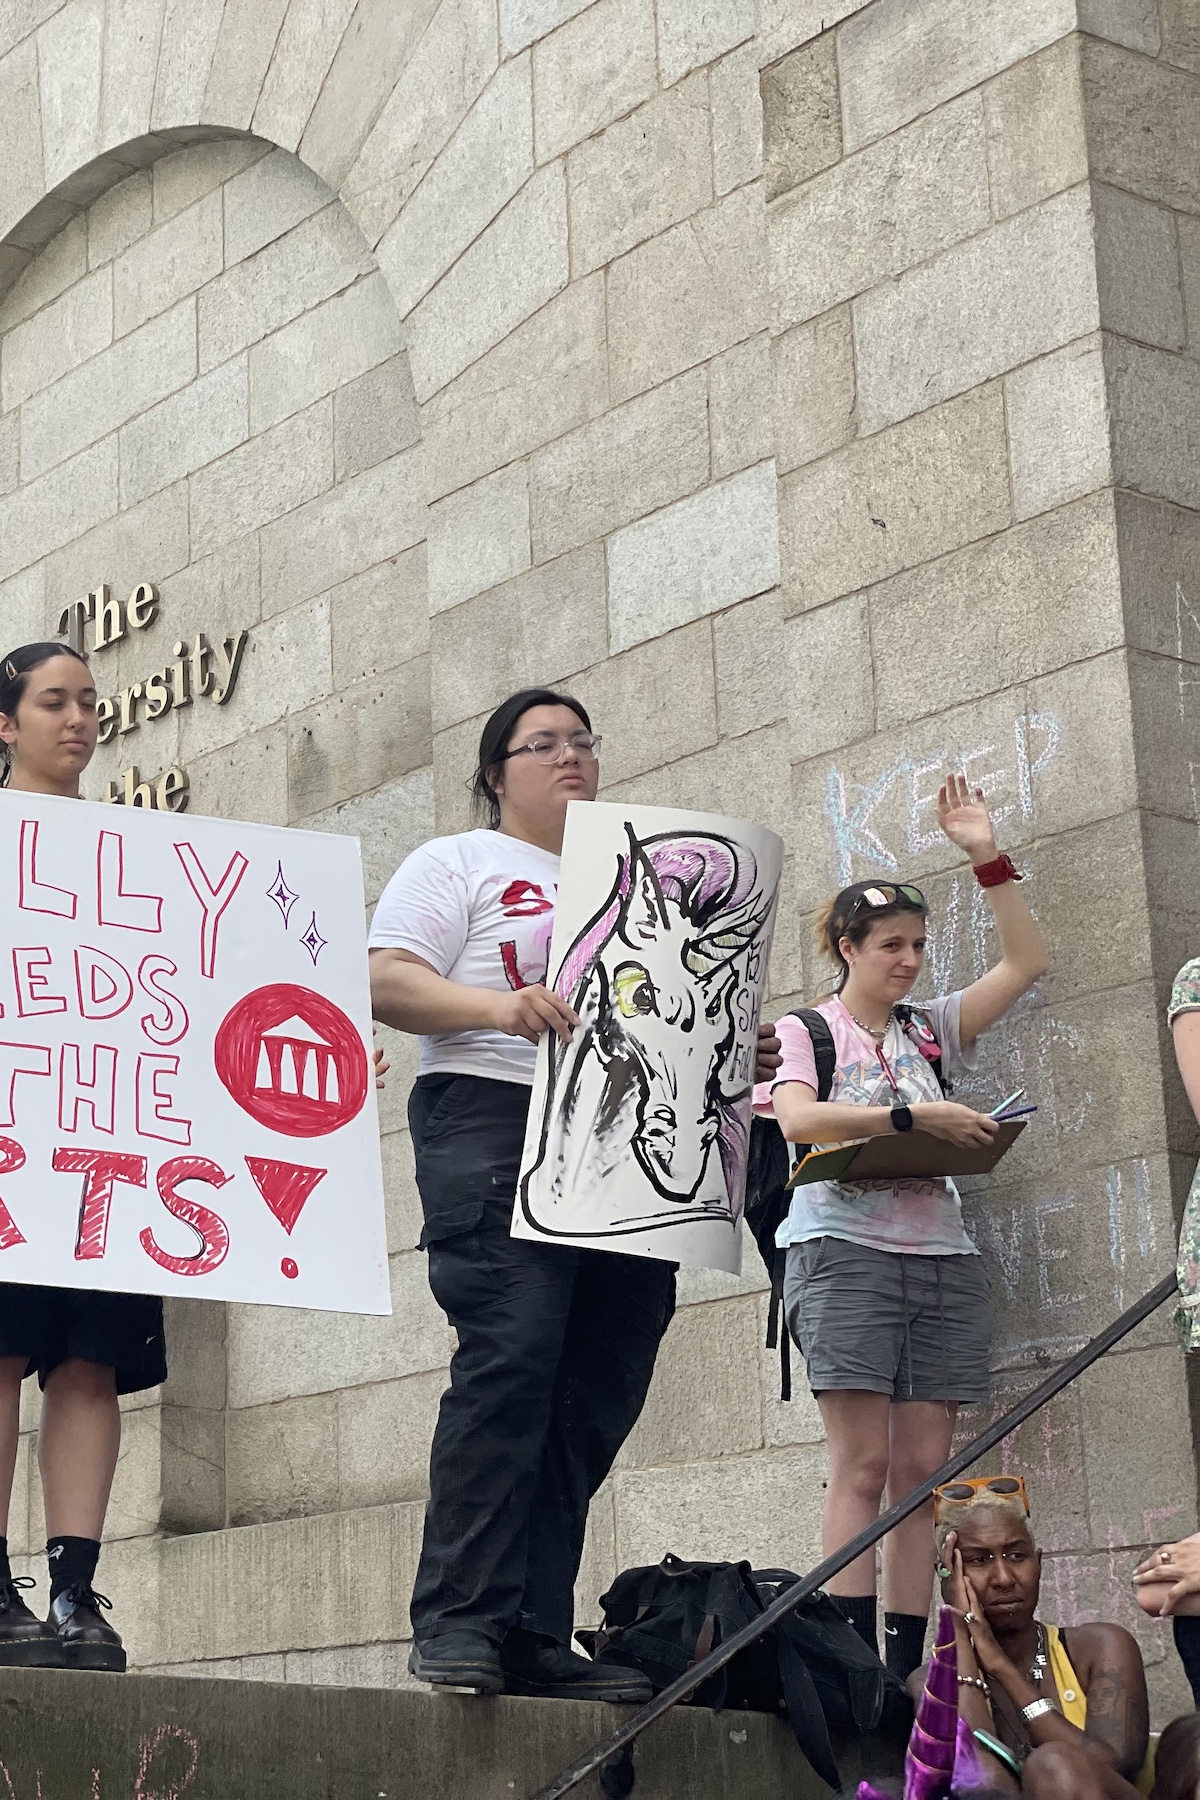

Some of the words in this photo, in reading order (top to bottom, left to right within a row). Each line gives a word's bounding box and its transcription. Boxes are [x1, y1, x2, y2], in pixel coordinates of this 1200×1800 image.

[58, 582, 159, 660] The
[97, 630, 249, 744] ersity
[824, 710, 1062, 886] KEEP
